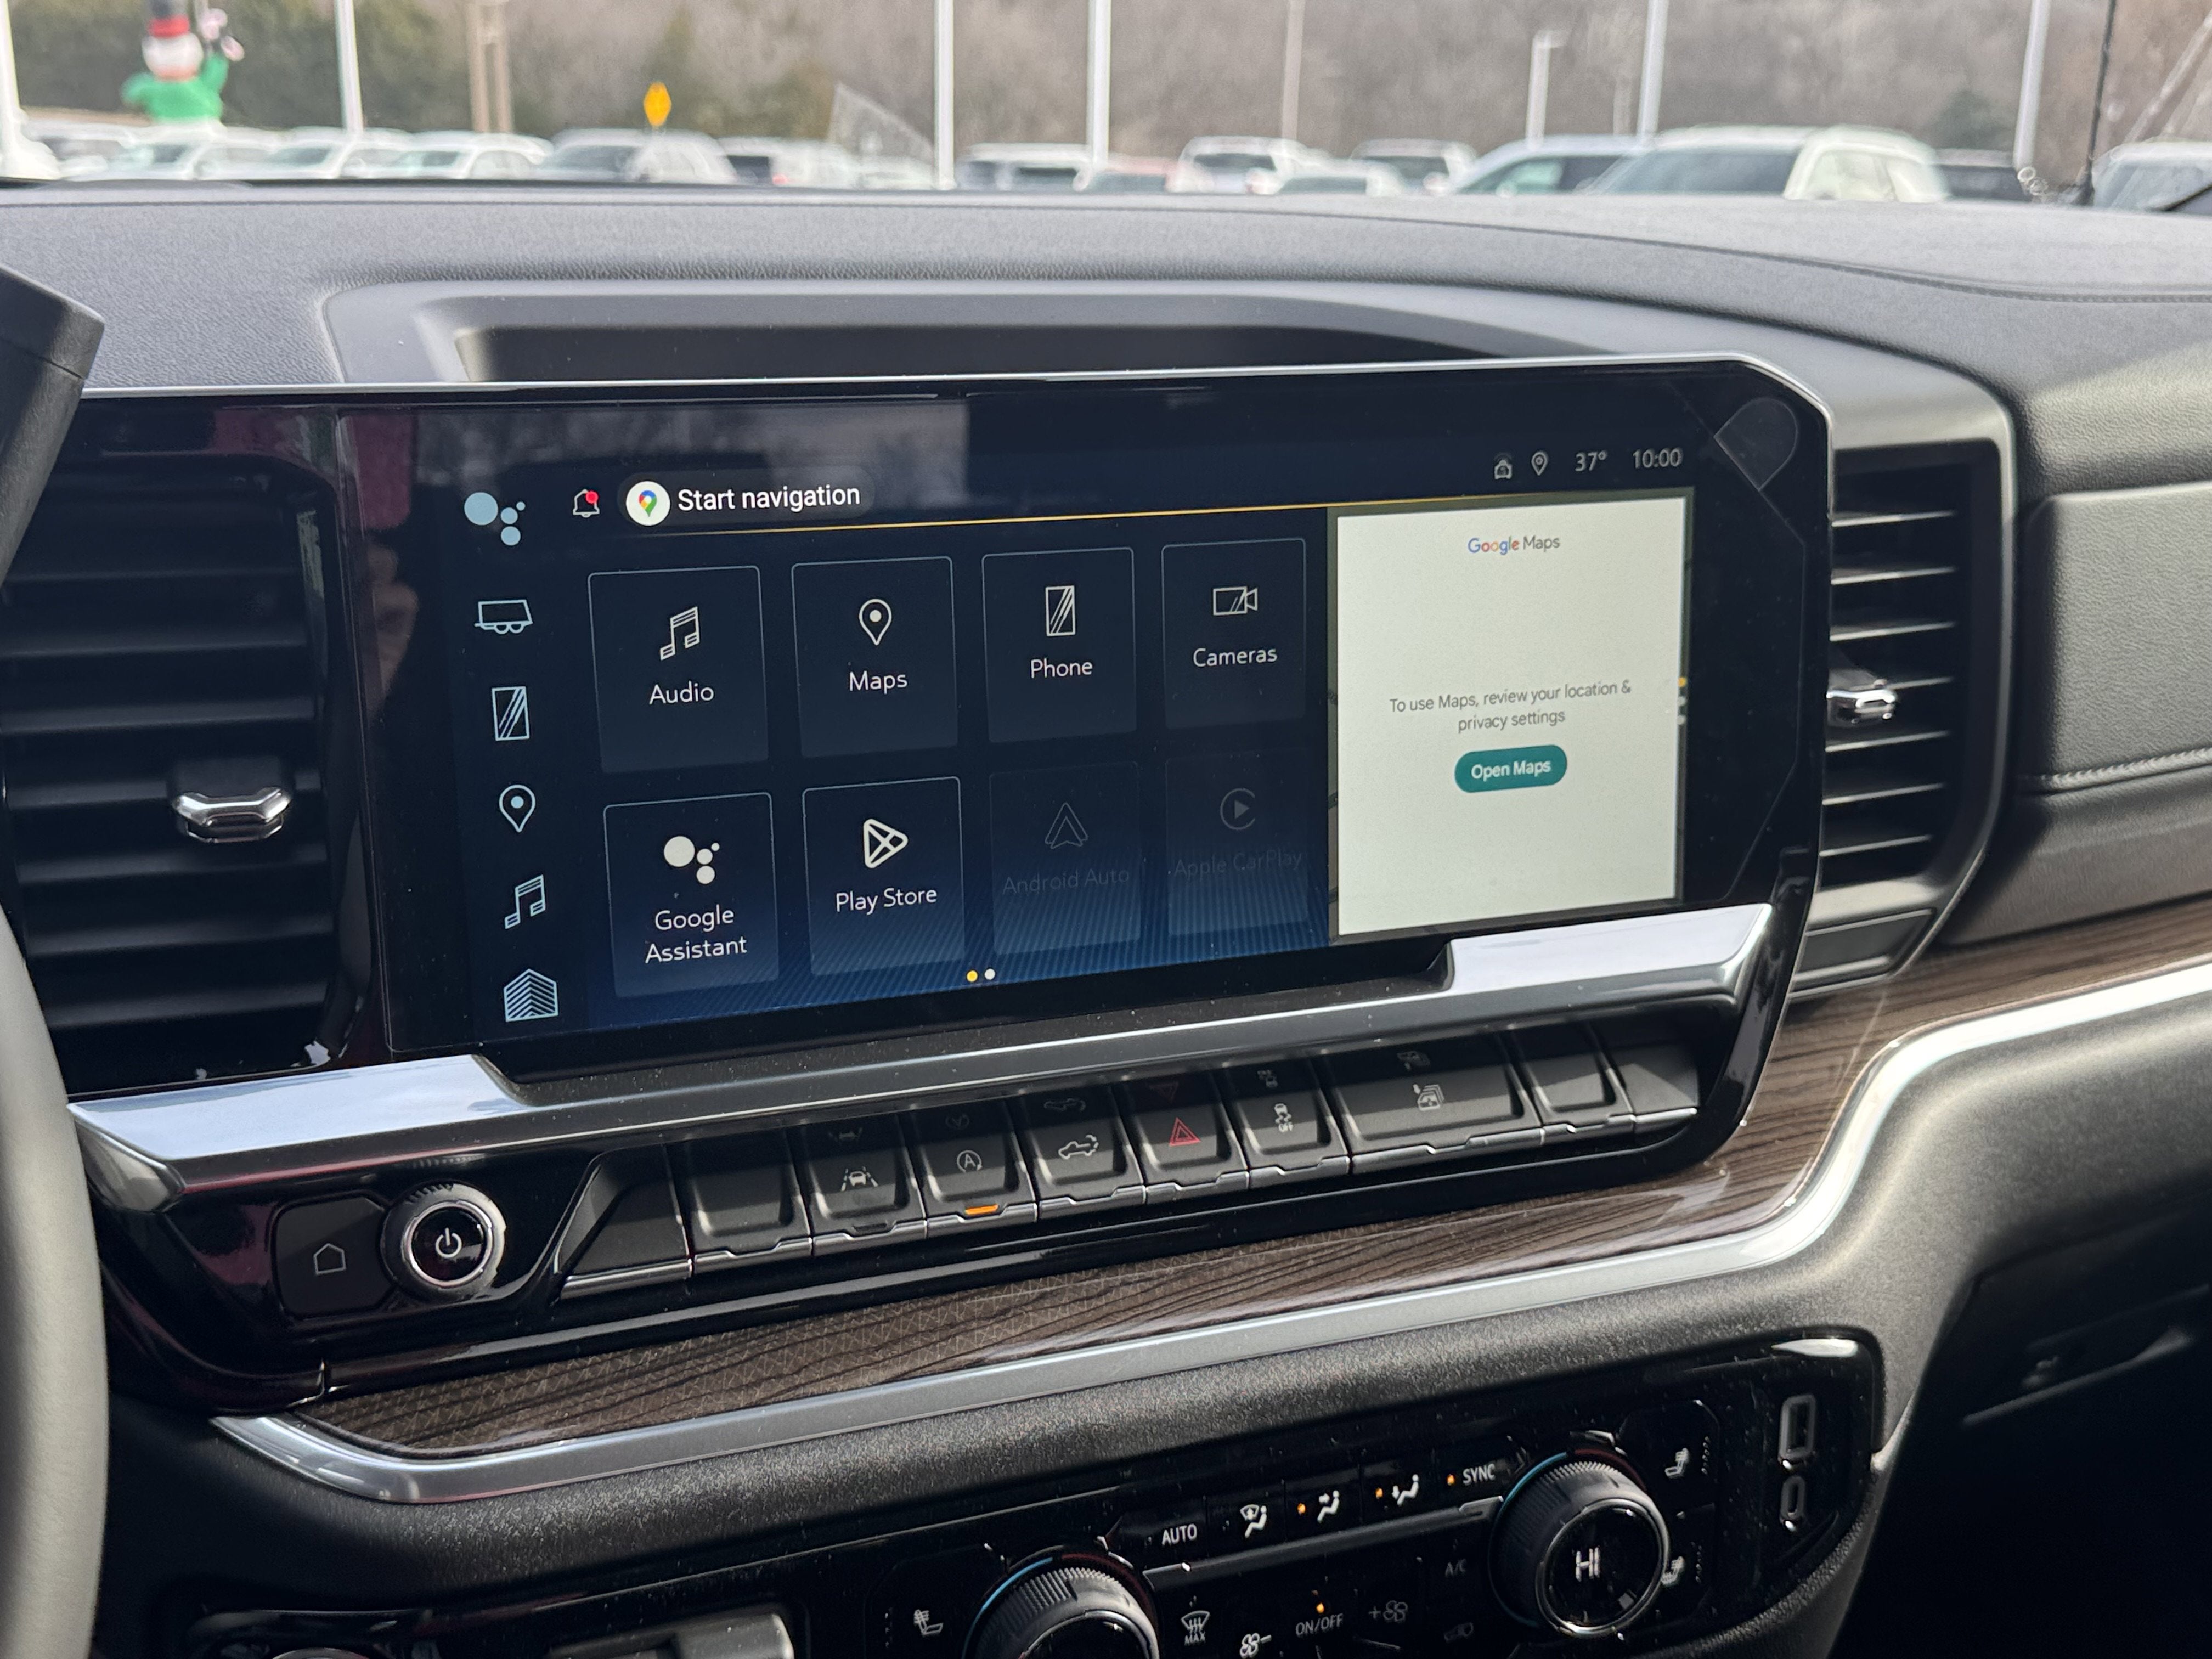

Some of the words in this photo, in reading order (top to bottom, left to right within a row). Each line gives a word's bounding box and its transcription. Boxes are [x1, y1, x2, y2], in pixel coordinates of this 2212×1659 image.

[1632, 447, 1683, 469] 10:00
[678, 488, 736, 511] Start
[742, 484, 860, 512] navigation
[1468, 535, 1520, 555] Google
[1522, 535, 1561, 552] Maps
[1030, 658, 1093, 679] Phone
[1192, 646, 1278, 668] Cameras
[649, 681, 714, 705] Audio
[849, 670, 908, 695] Maps
[1390, 698, 1407, 713] To
[1409, 698, 1435, 712] use
[1438, 693, 1480, 710] Maps,
[1483, 690, 1528, 706] review
[1530, 687, 1561, 705] your
[1564, 681, 1618, 699] location
[1621, 680, 1632, 695] &
[1458, 714, 1508, 733] privacy
[1510, 710, 1566, 728] settings
[1470, 763, 1510, 782] Open
[1513, 758, 1551, 777] Maps
[1172, 855, 1227, 882] Apple
[1232, 847, 1304, 872] CarPlay
[1002, 869, 1079, 895] Android
[1084, 867, 1131, 886] Auto
[836, 891, 878, 915] Play
[883, 887, 938, 908] Store
[654, 904, 735, 932] Google
[645, 935, 747, 964] Assistant
[1462, 1463, 1496, 1485] SYNC
[1161, 1523, 1198, 1545] AUTO
[1575, 1547, 1601, 1582] HI
[1295, 1613, 1344, 1637] ON/OFF
[1184, 1631, 1206, 1645] MAX
